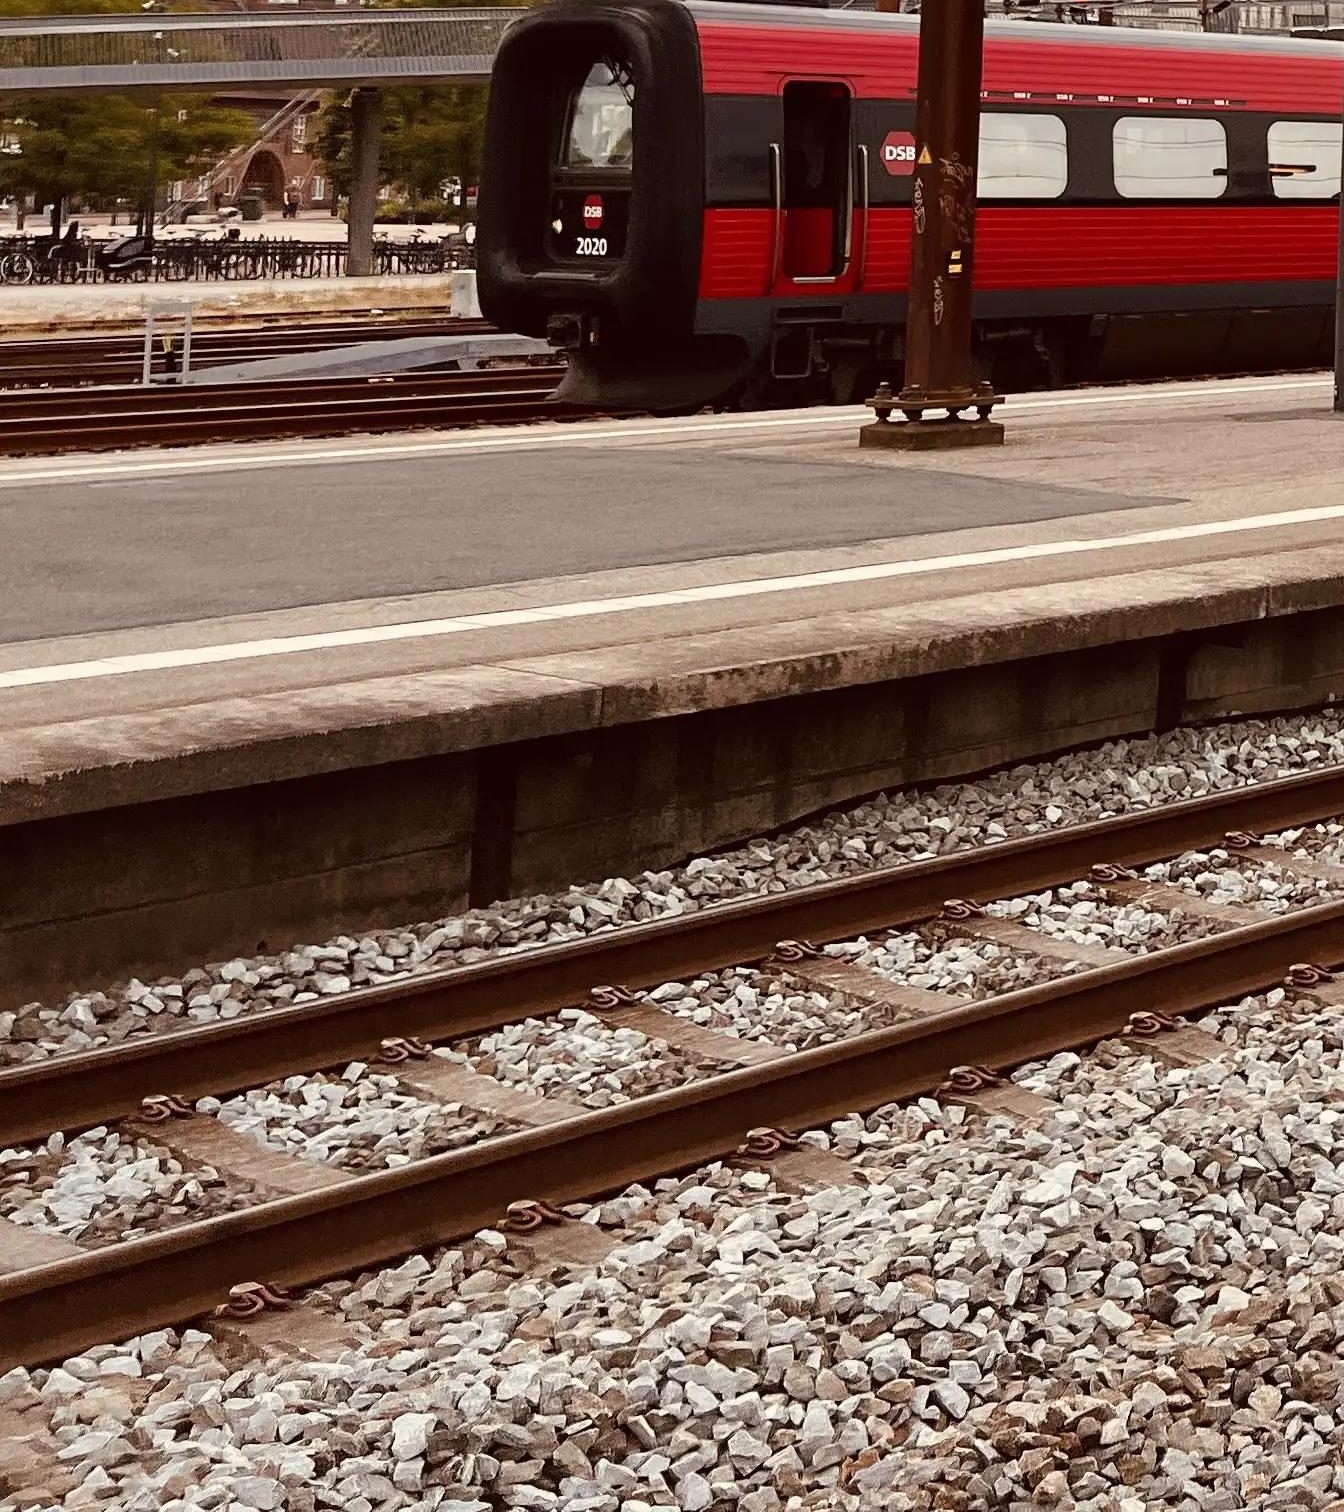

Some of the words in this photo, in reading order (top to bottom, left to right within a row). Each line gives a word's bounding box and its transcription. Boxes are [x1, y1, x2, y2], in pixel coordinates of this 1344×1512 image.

[885, 145, 916, 161] DSB
[584, 205, 603, 218] DSB
[575, 236, 608, 256] 2020
